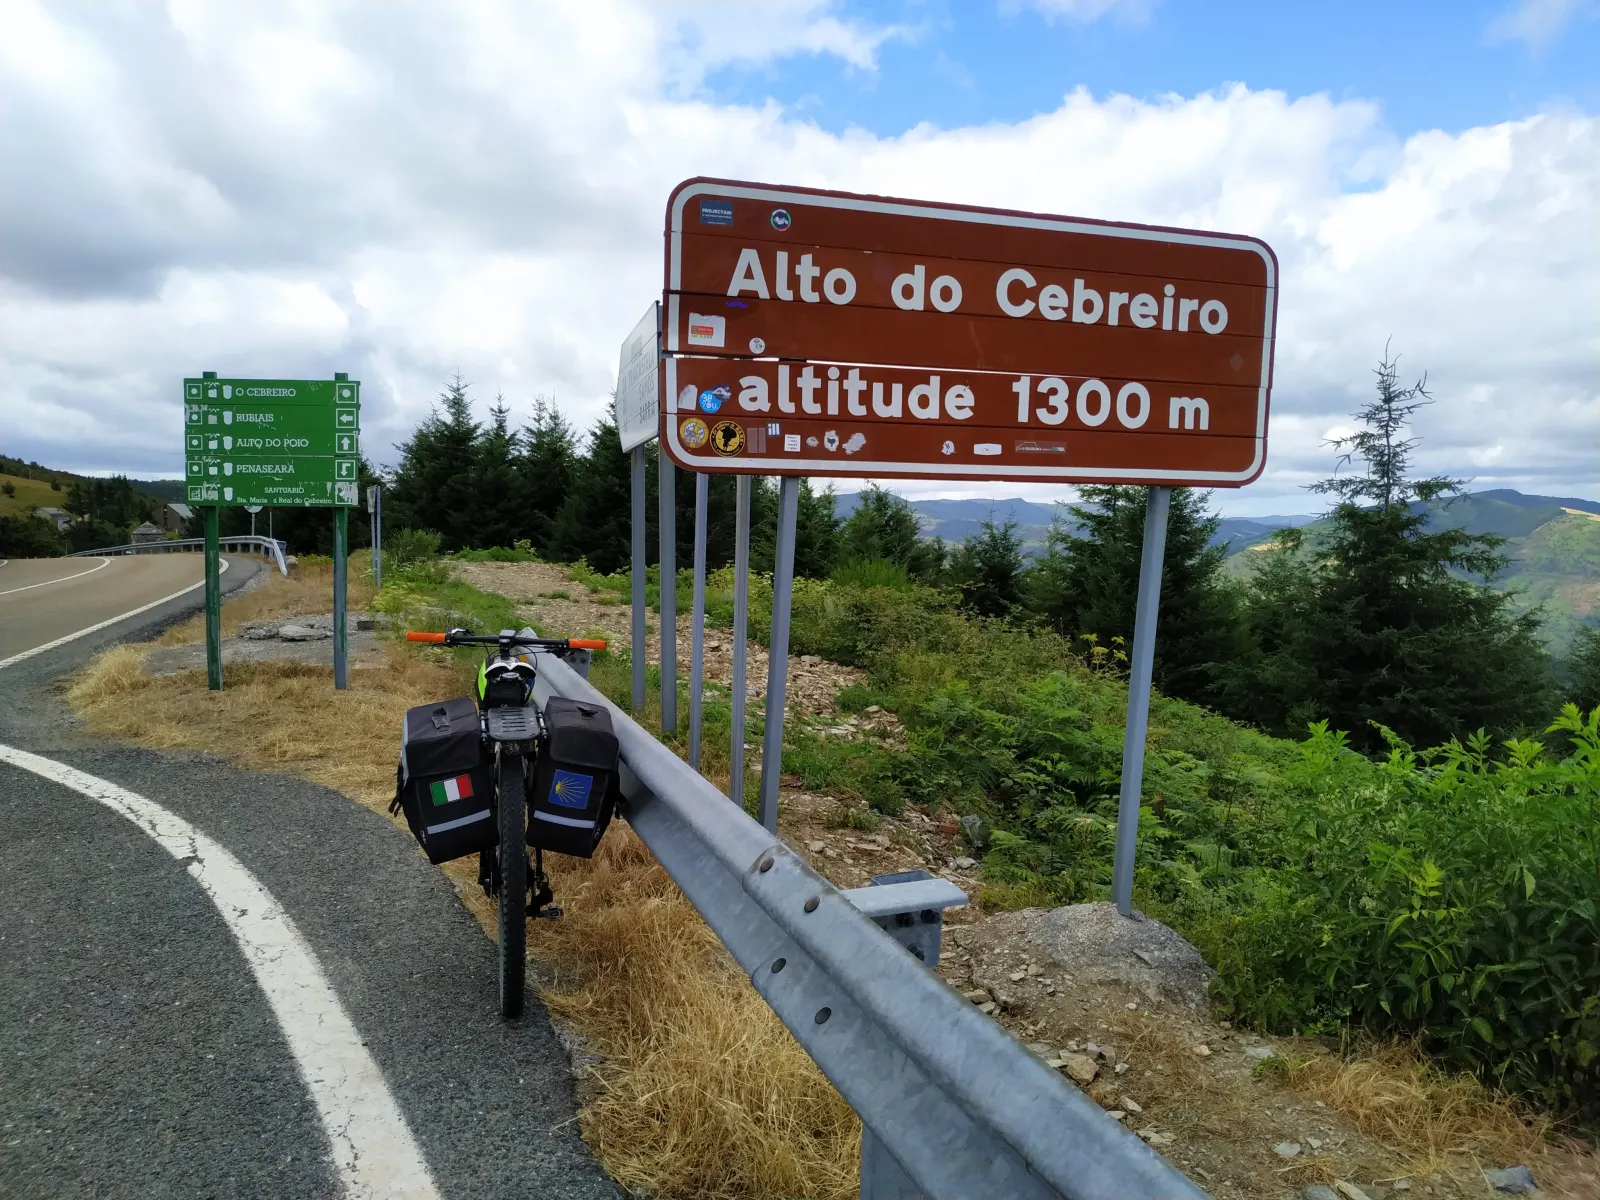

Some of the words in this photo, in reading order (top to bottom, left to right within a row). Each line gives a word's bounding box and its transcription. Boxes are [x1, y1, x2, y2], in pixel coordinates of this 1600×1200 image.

[727, 249, 857, 307] Alto
[890, 264, 963, 313] do
[995, 268, 1229, 335] Cebreiro
[235, 387, 244, 396] O
[246, 387, 296, 397] CEBREIRO
[738, 364, 975, 420] altitude
[1012, 376, 1151, 430] 1300
[1168, 397, 1210, 431] m
[236, 413, 274, 422] RUBIAIS
[236, 438, 263, 449] ALTO
[265, 438, 281, 447] DO
[283, 438, 309, 448] POIO
[278, 496, 292, 504] Real
